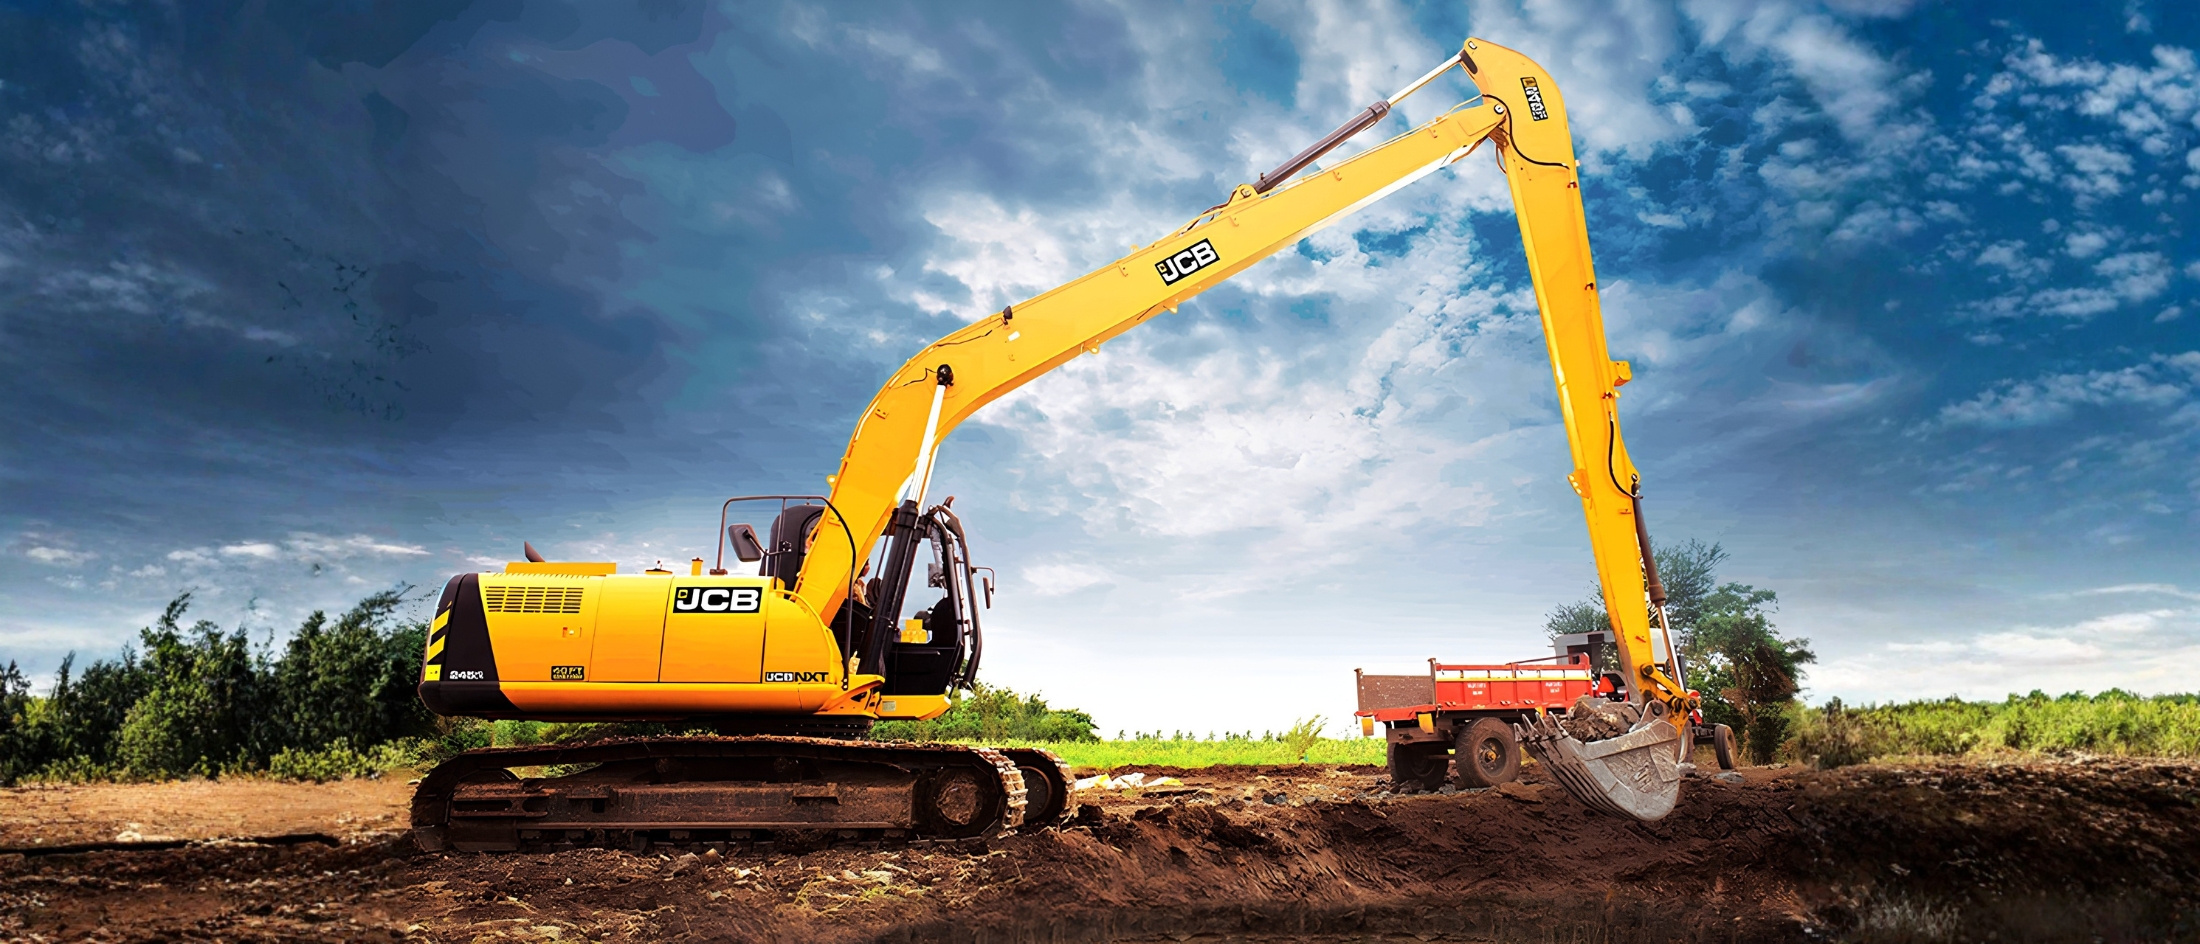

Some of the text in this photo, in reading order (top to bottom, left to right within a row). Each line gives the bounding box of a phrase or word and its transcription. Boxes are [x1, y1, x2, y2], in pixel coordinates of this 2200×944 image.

[1161, 241, 1217, 282] JCB
[676, 588, 760, 611] JCB
[794, 671, 829, 682] NXT
